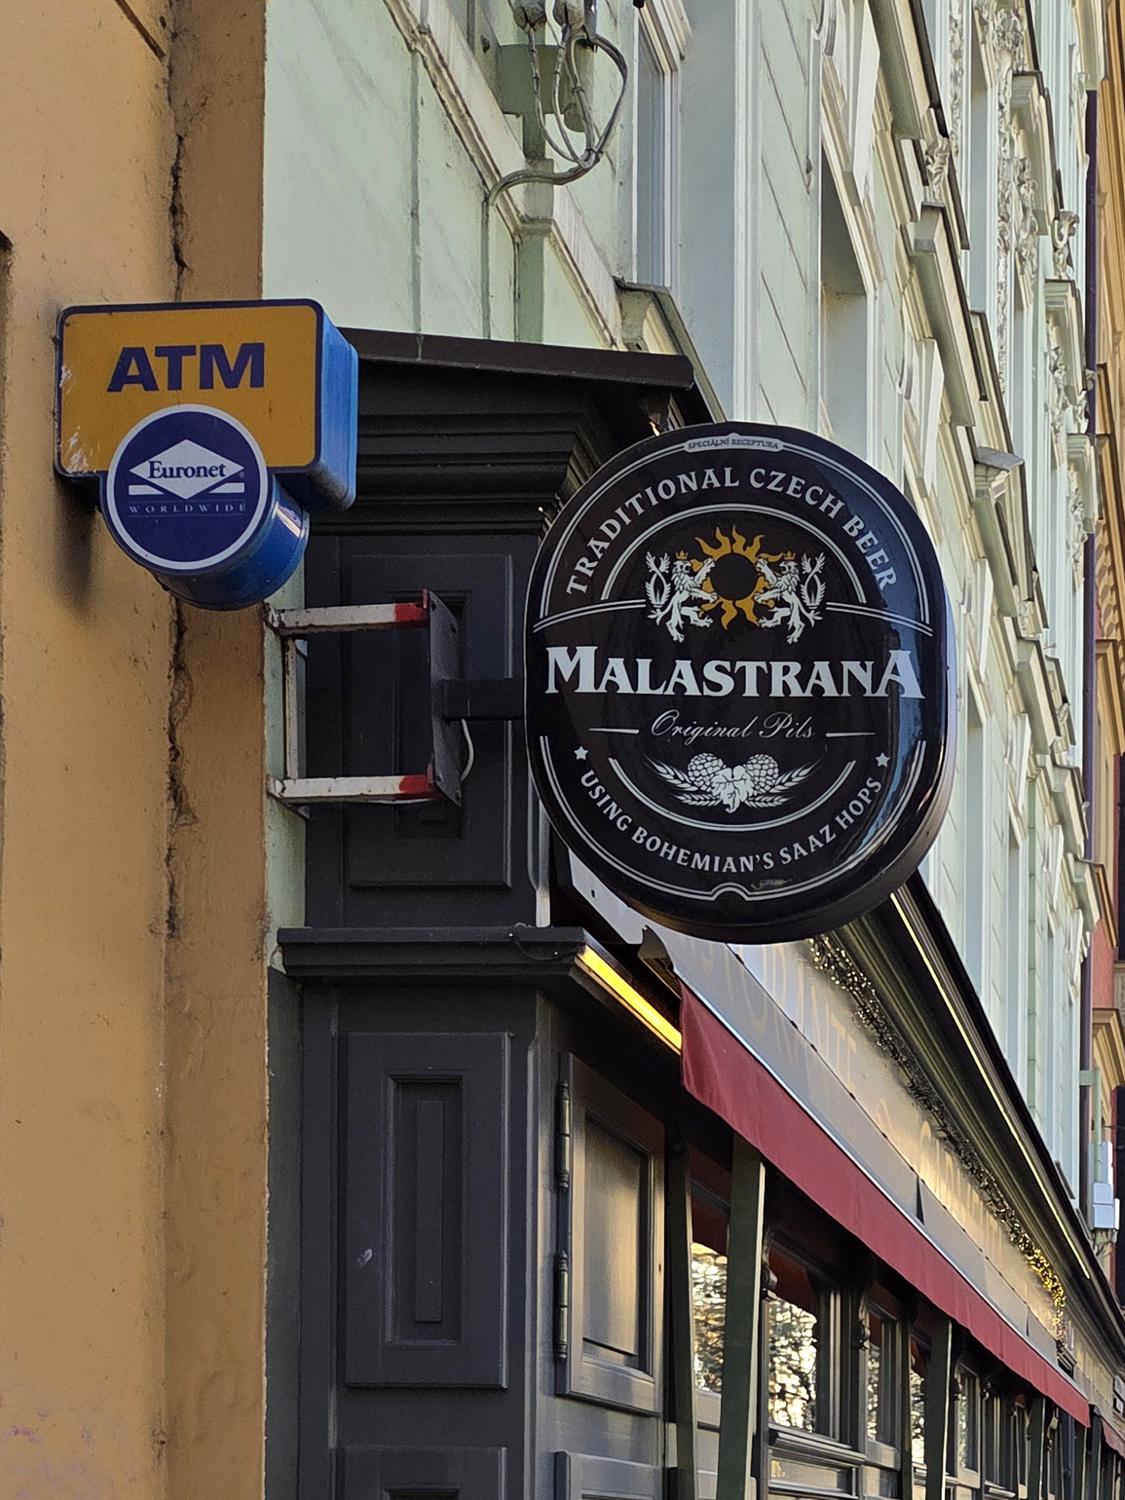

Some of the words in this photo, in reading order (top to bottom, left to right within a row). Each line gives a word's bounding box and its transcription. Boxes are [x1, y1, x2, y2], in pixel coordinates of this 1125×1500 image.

[106, 342, 265, 393] ATM
[148, 460, 227, 479] Euronet
[128, 503, 247, 514] WORLDWIDE
[565, 467, 741, 595] TRADITIONAL
[749, 467, 845, 519] CZECH
[842, 514, 897, 592] BEER
[545, 645, 925, 700] MALASTRANA
[650, 708, 758, 746] Original
[758, 711, 815, 739] Pils
[580, 769, 632, 832] USING
[779, 824, 837, 866] SAAZ
[834, 776, 882, 830] HOPS
